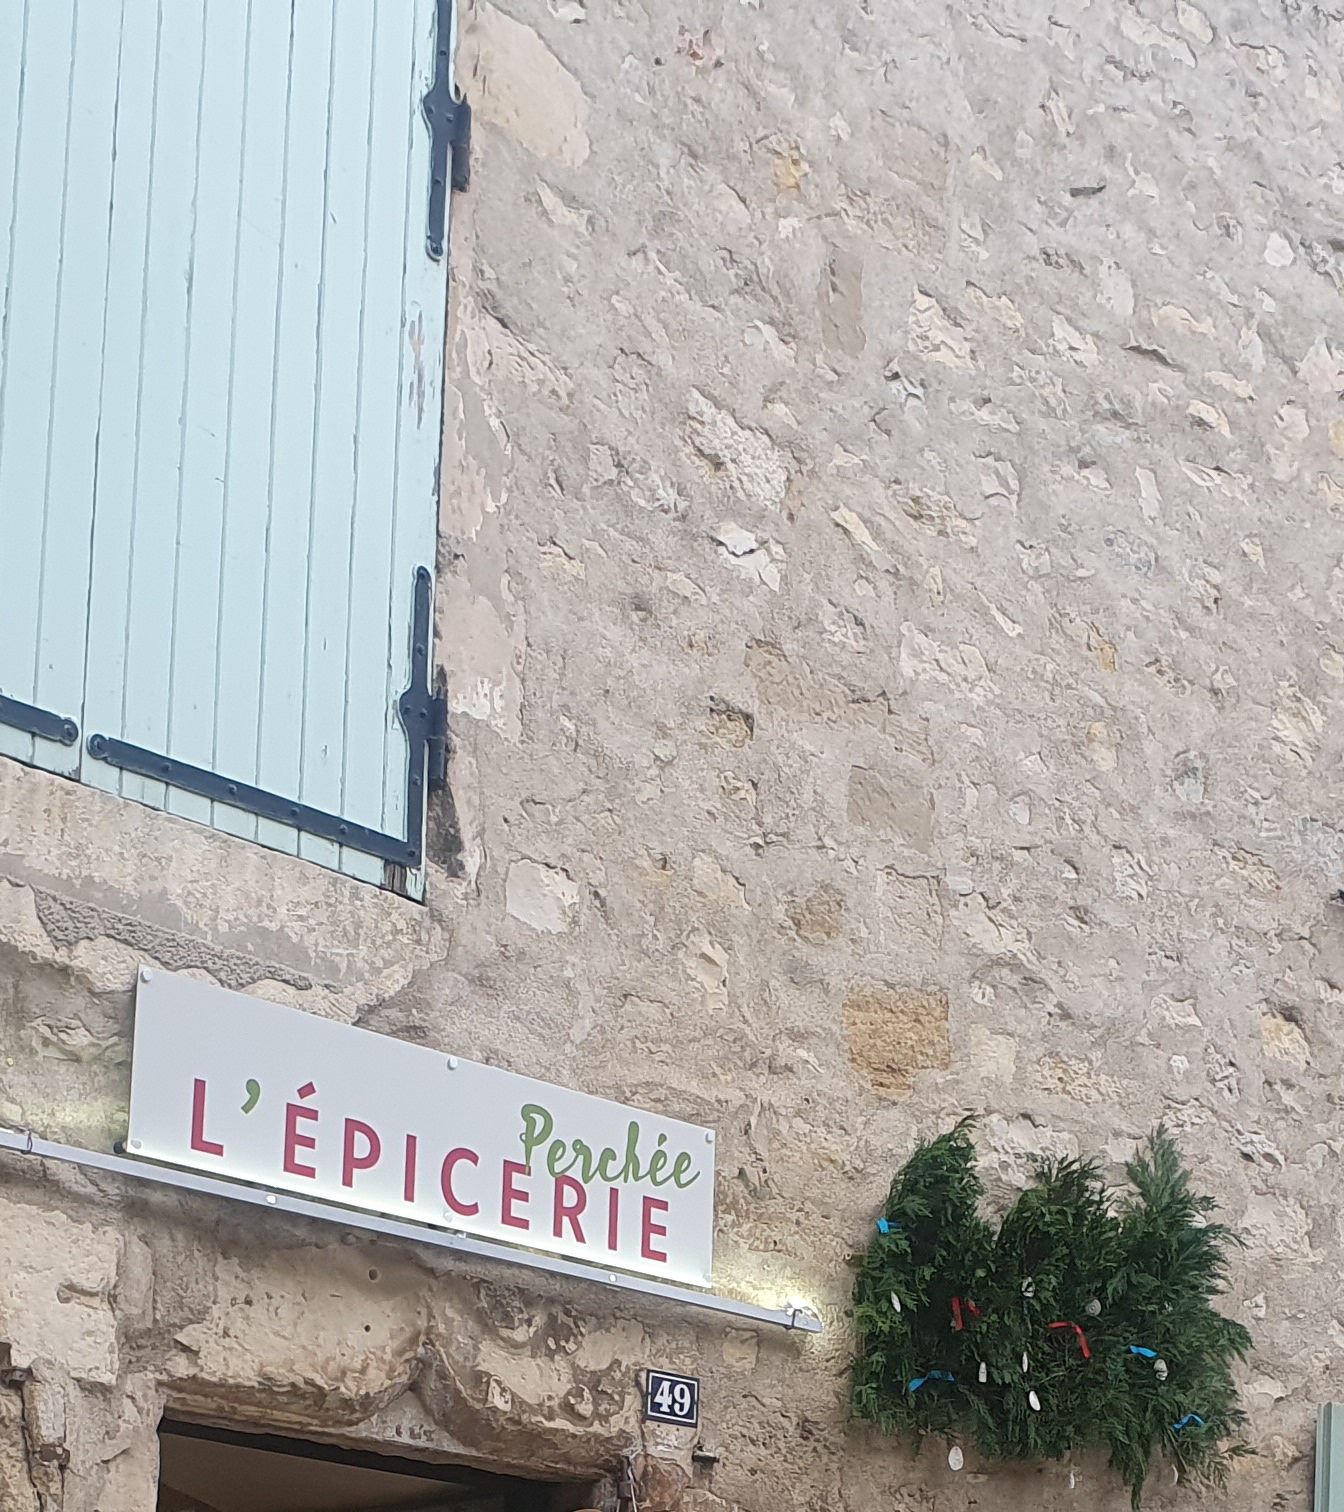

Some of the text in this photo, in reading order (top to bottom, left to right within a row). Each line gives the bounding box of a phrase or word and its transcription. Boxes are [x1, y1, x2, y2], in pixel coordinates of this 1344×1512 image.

[191, 1077, 669, 1263] L'ÉPICERIE
[519, 1104, 701, 1190] Perchée
[653, 1380, 692, 1417] 49
